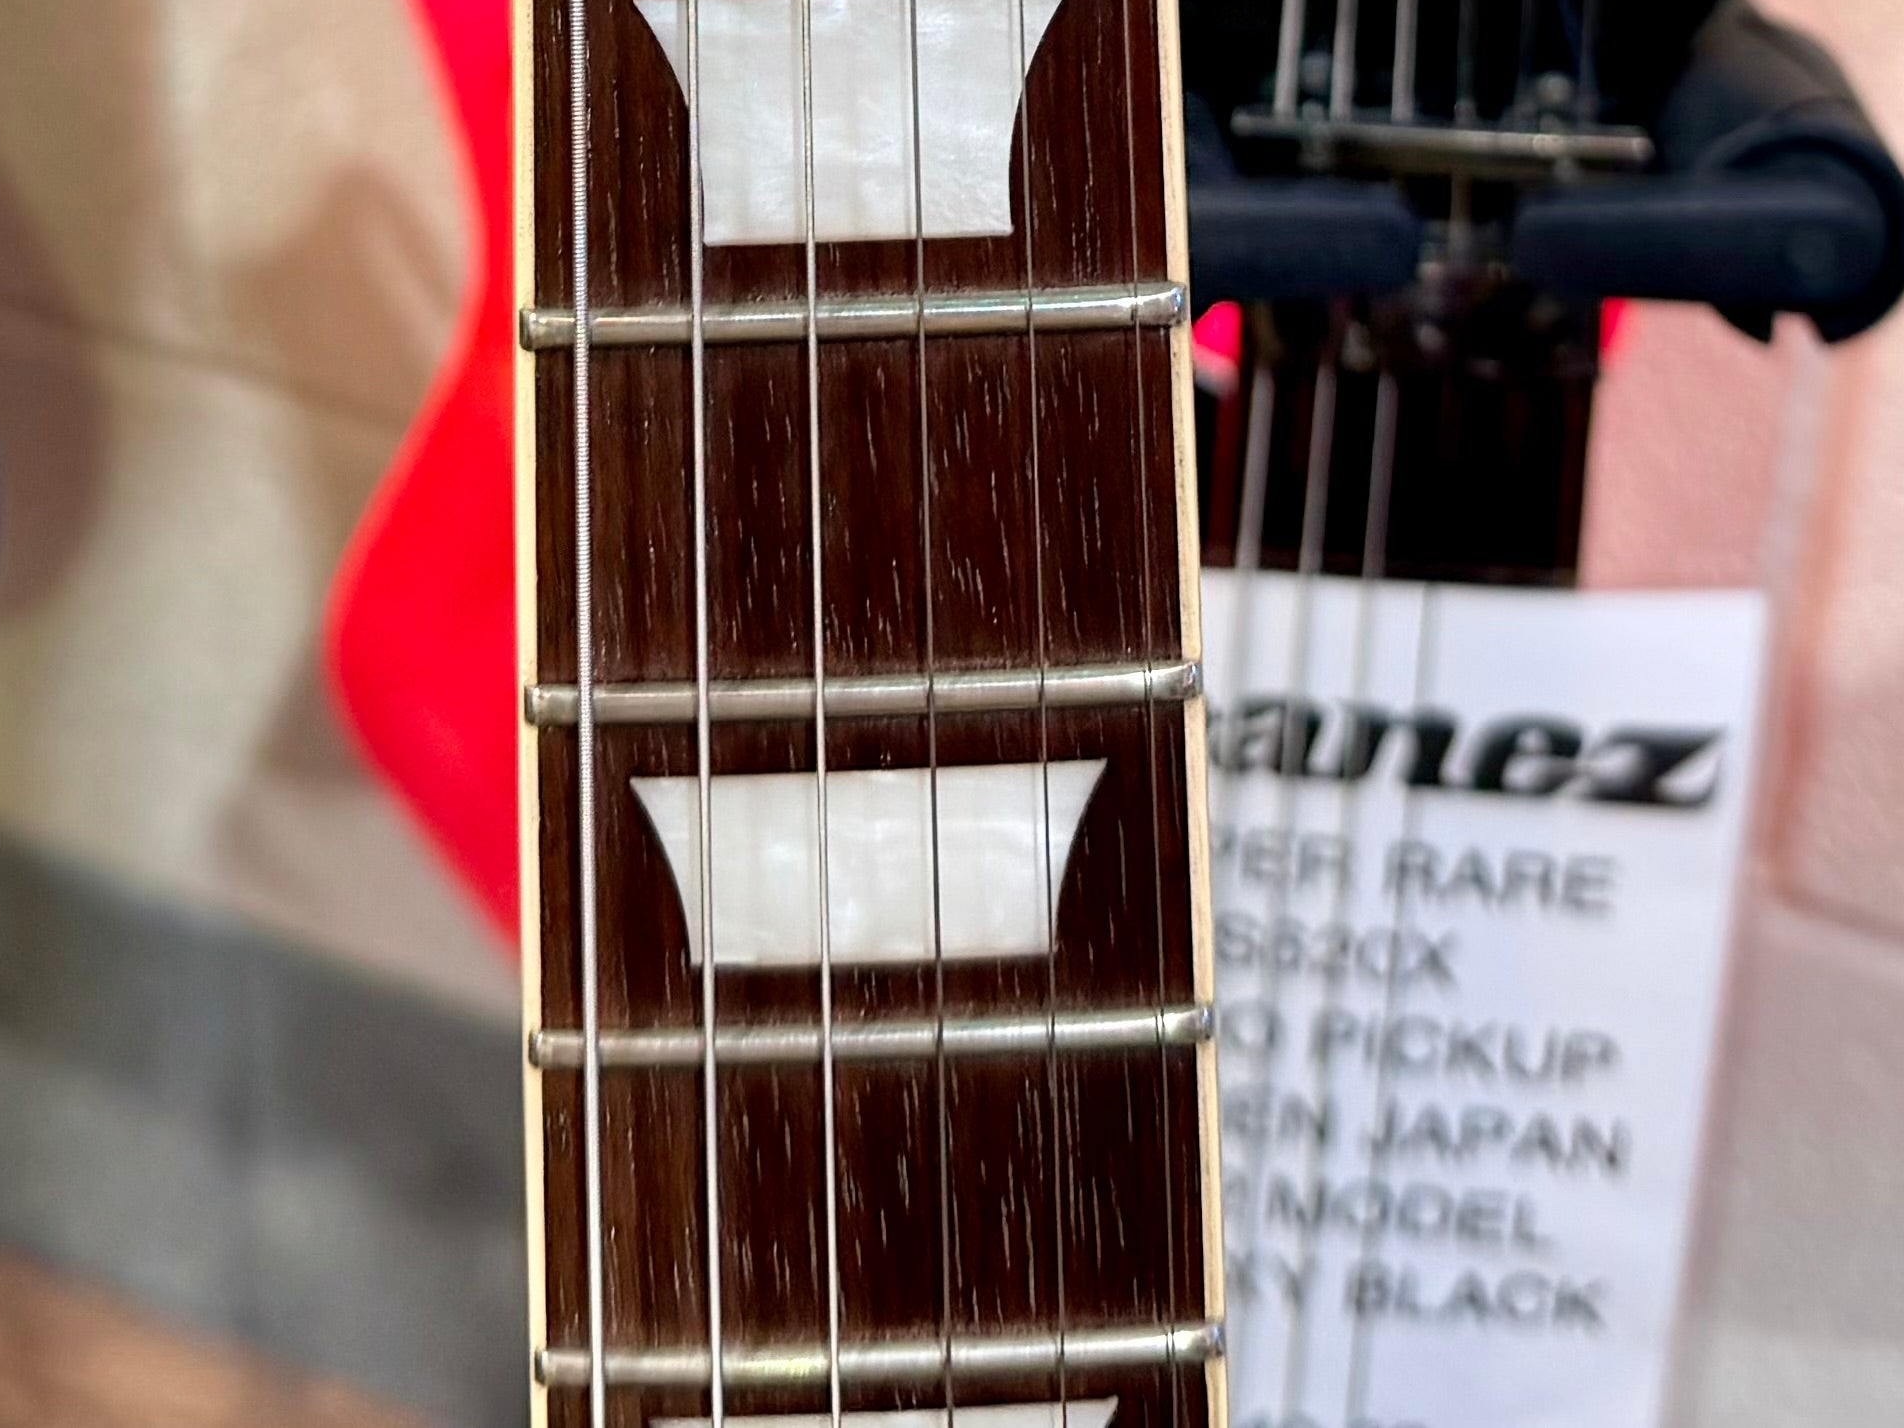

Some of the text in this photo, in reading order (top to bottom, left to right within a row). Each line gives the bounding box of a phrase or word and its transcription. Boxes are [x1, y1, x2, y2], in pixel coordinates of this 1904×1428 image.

[1206, 692, 1728, 808] anez
[1384, 837, 1619, 916] RARE
[1309, 1004, 1621, 1086] PICKUP
[1369, 1097, 1631, 1176] JAPAN
[1264, 1172, 1552, 1254] MODEL
[1346, 1258, 1609, 1332] BLACK
